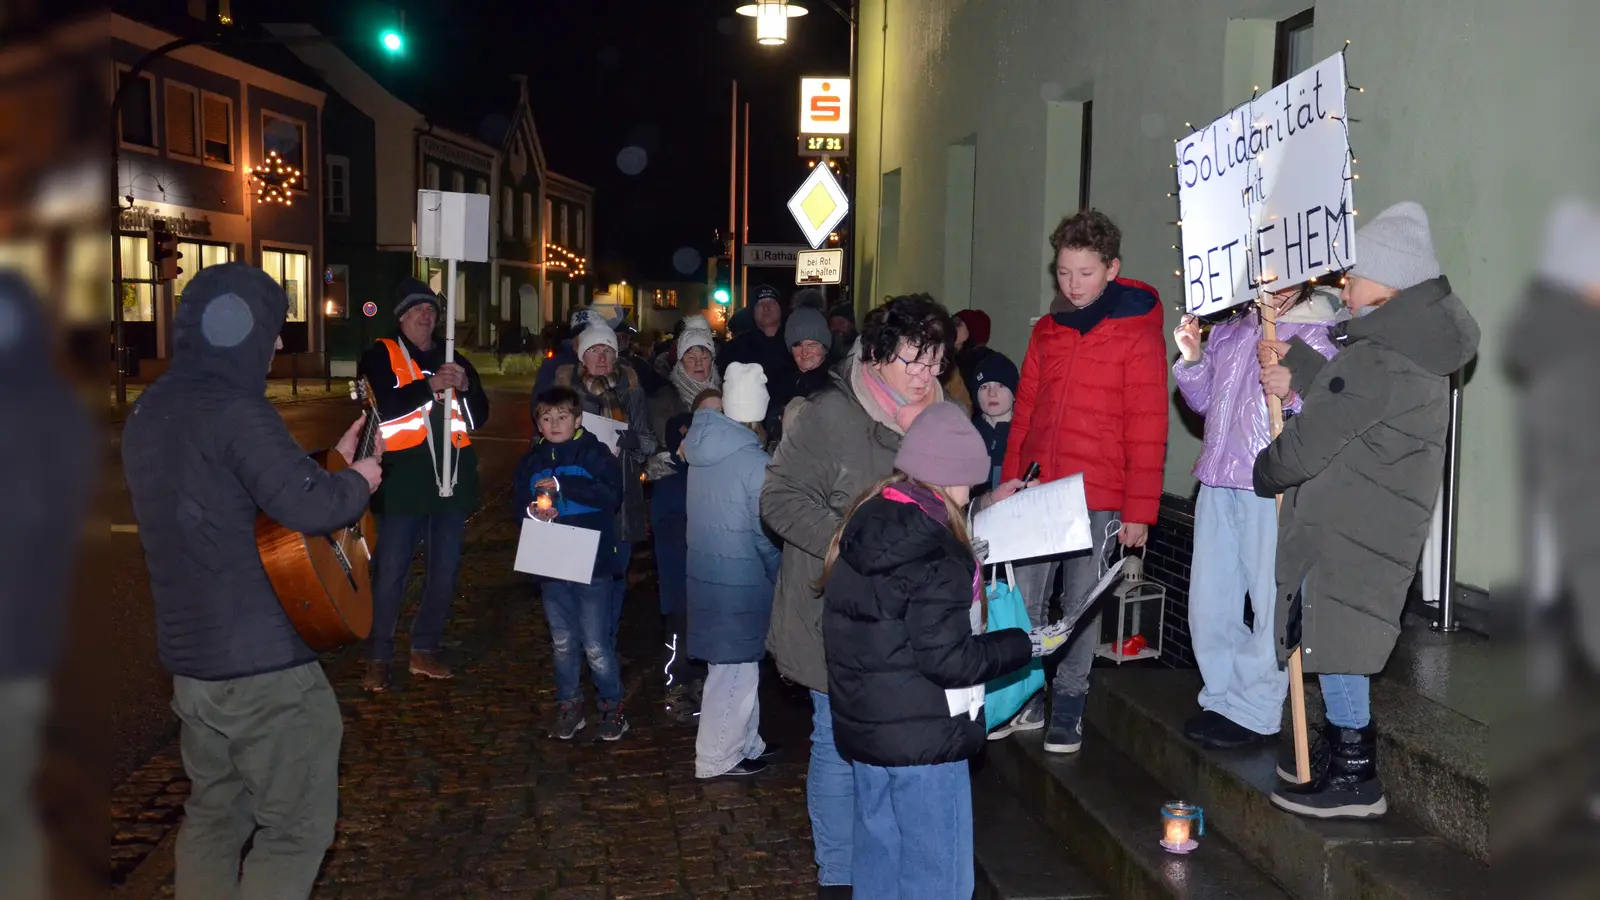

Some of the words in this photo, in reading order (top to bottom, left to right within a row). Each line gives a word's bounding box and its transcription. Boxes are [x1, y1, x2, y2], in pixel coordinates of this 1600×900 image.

[1182, 70, 1326, 188] Solidarität
[1241, 168, 1266, 208] mit
[764, 250, 797, 261] Rathau
[807, 257, 817, 266] bei
[819, 256, 831, 266] Rot
[1188, 199, 1349, 311] BETLEHEM
[800, 268, 813, 277] hier
[815, 267, 837, 277] halten
